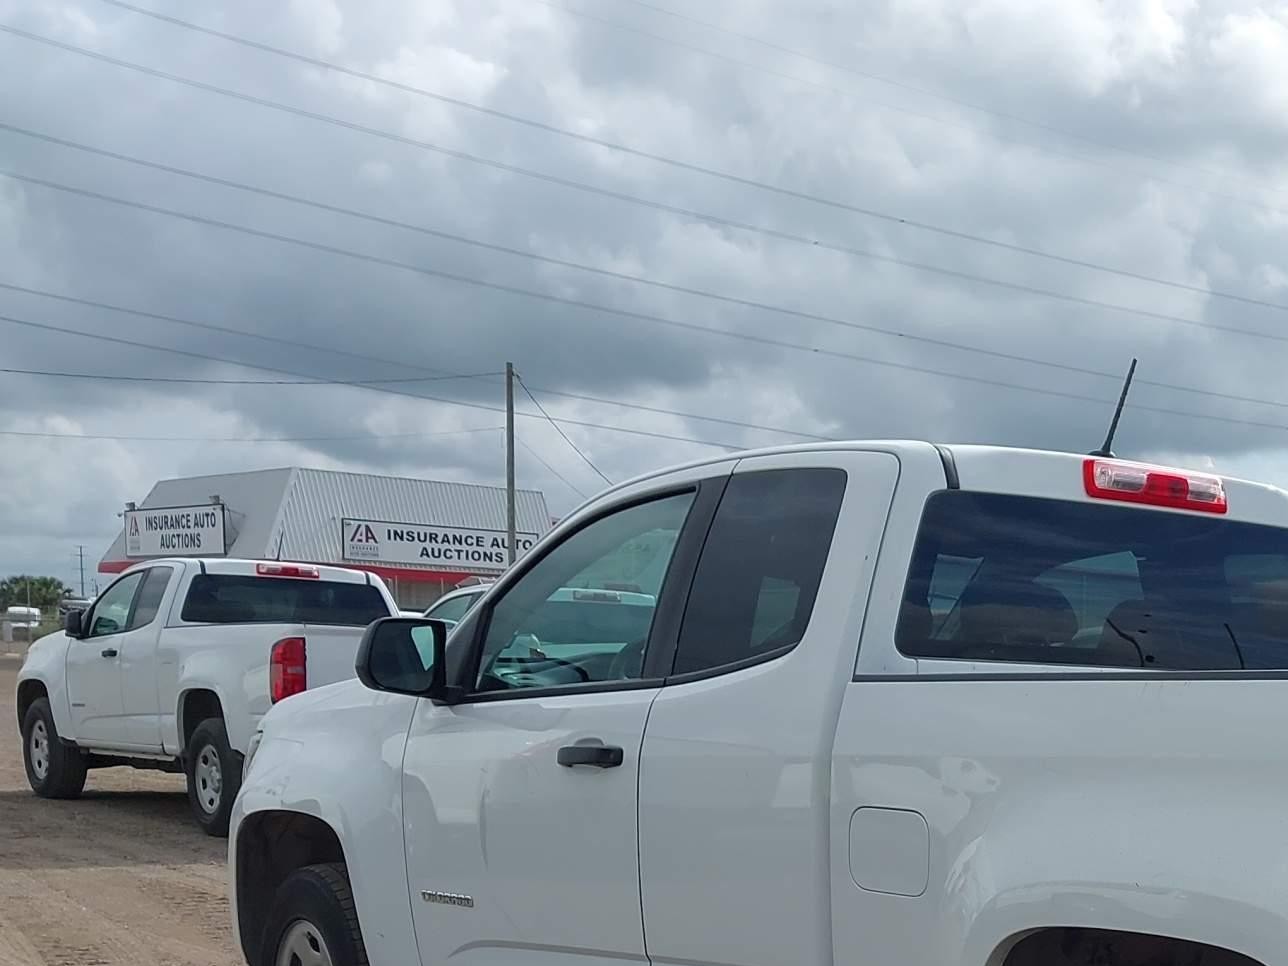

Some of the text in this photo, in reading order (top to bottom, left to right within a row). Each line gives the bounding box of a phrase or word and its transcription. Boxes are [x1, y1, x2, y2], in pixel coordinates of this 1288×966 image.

[145, 511, 216, 531] INSURANCE AUTO
[160, 532, 201, 549] AUCTIONS
[387, 528, 533, 551] INSURANCE AUTO
[419, 546, 504, 563] AUCTIONS
